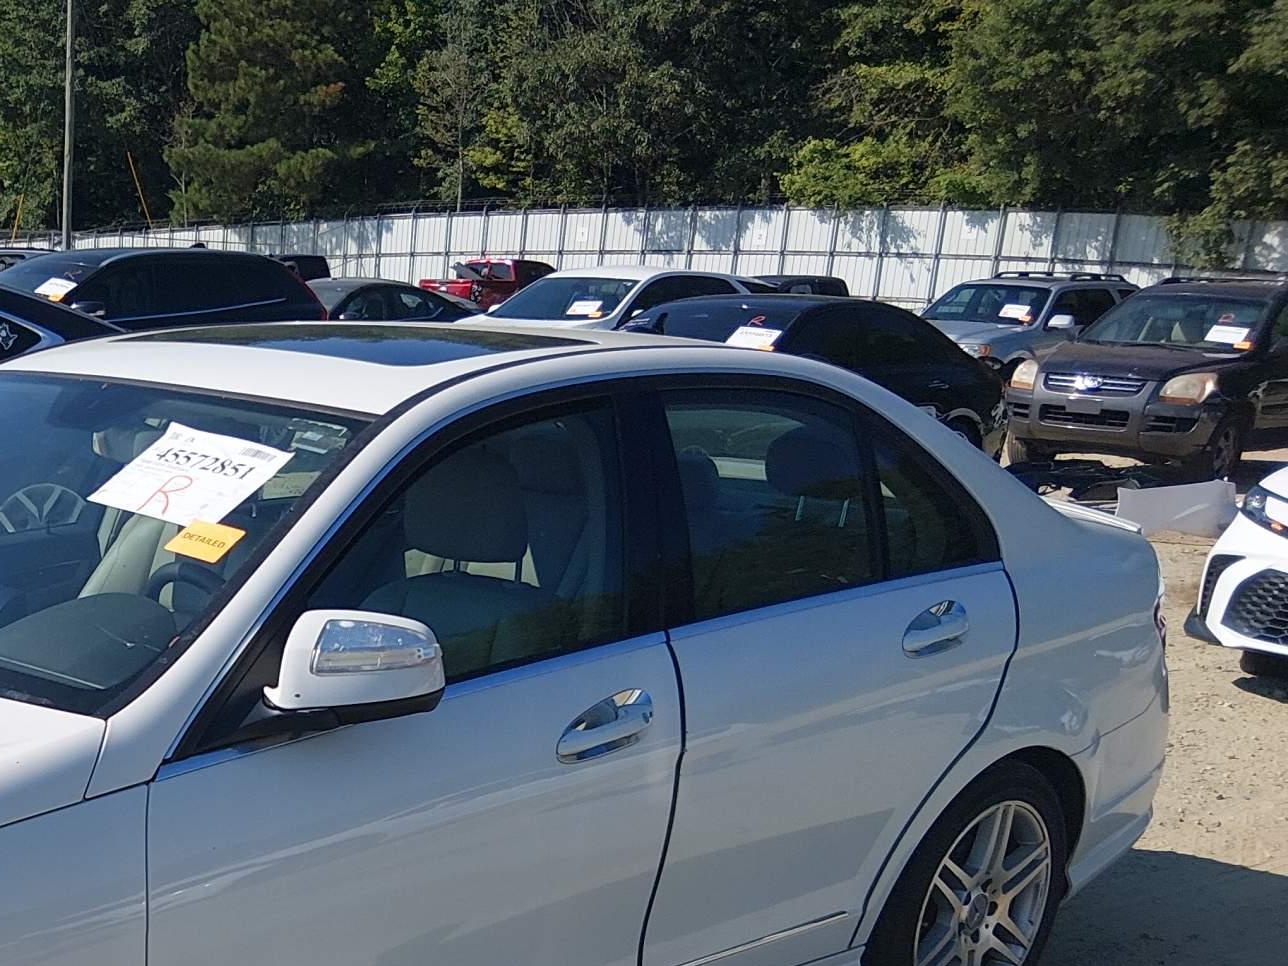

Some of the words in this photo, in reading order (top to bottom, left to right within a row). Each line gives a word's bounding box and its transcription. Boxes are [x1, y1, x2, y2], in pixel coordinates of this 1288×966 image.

[156, 447, 256, 480] 45572851
[136, 474, 193, 514] R
[182, 532, 226, 549] DETAILED
